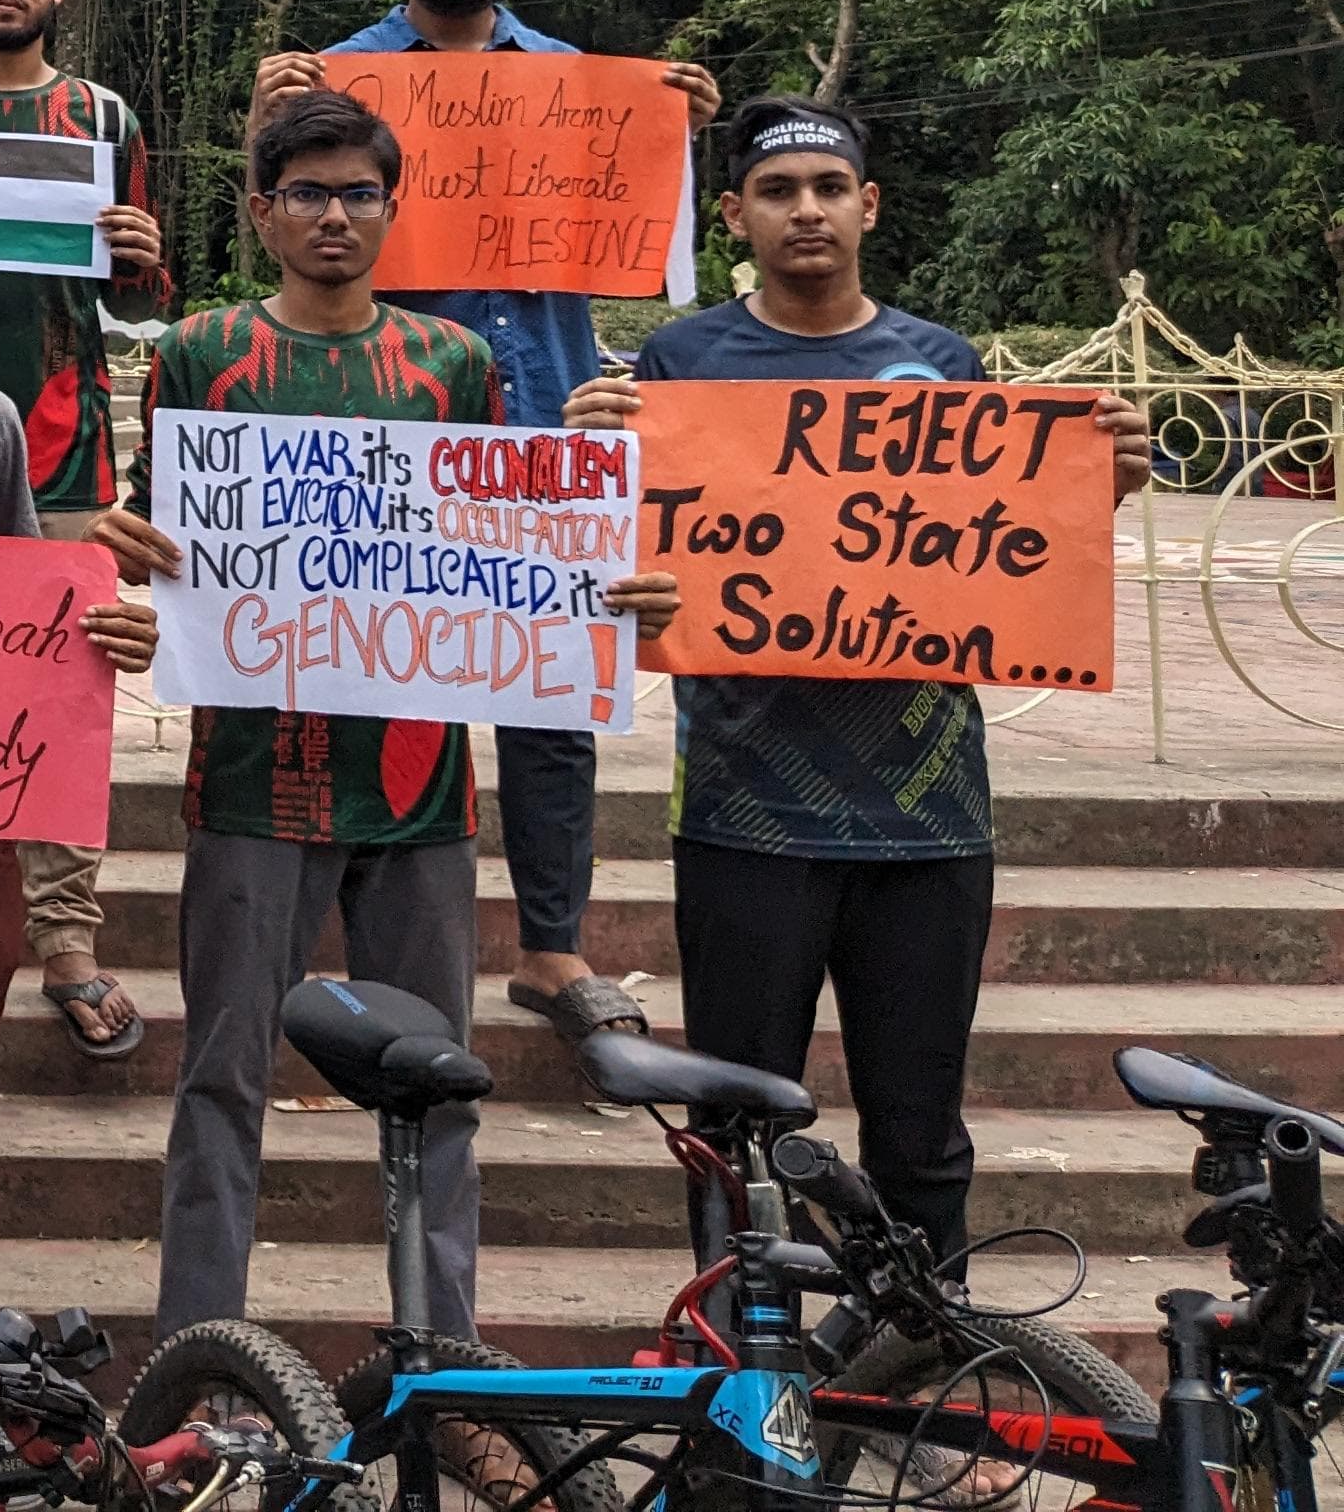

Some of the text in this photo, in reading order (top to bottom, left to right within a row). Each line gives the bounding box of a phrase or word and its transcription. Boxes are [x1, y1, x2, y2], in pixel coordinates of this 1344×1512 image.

[399, 69, 527, 129] Muslim
[538, 77, 634, 158] Army
[752, 122, 842, 145] MUSLIMS ARE
[761, 133, 837, 150] ONE BODY
[399, 146, 633, 203] Must Liberate
[466, 213, 673, 277] PALESTINE
[176, 422, 250, 475] NOT
[429, 430, 629, 504] COLONIALISM
[771, 388, 1099, 482] REJECT
[179, 476, 253, 532] NOT
[436, 496, 633, 563] OCCUPATION
[642, 485, 1051, 578] Two State
[190, 532, 291, 590] NOT
[588, 1375, 664, 1390] PROJECT 3.0
